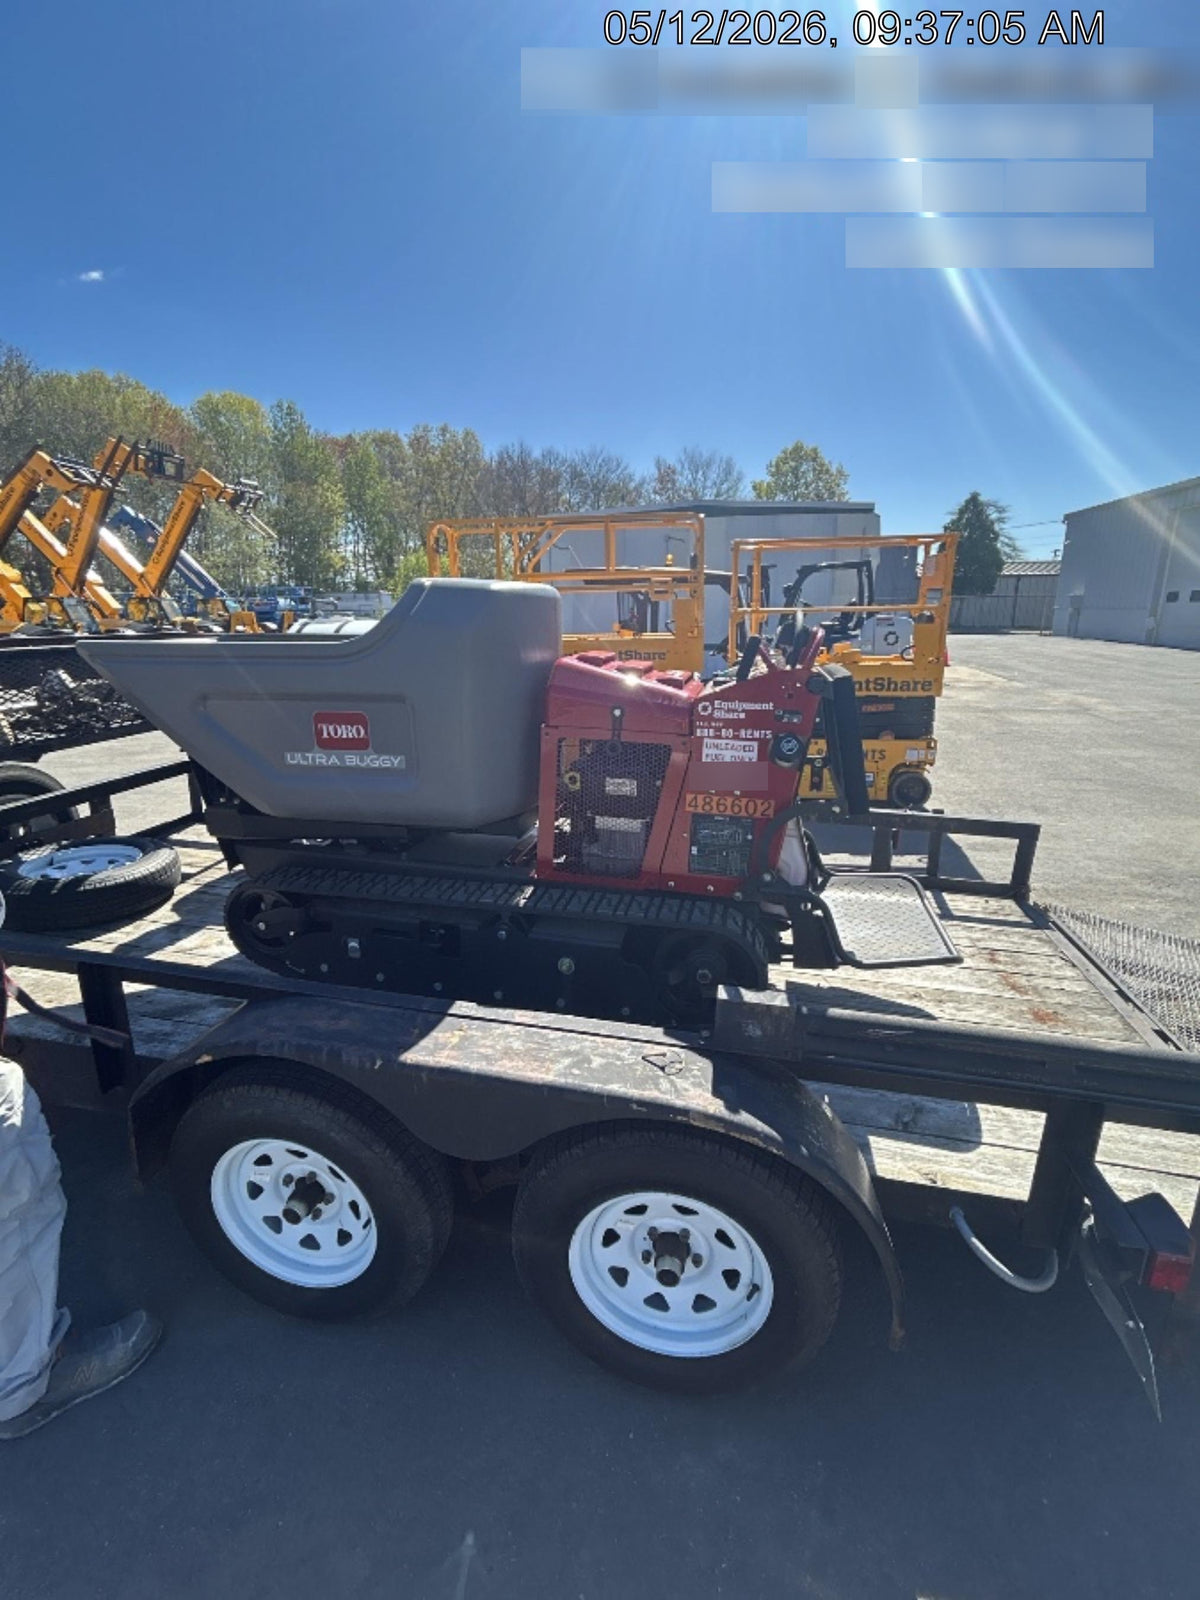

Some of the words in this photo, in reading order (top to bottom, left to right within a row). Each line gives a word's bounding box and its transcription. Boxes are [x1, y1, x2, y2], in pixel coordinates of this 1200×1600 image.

[713, 700, 774, 712] Equipment
[713, 708, 746, 719] Share
[318, 723, 367, 739] TORO
[286, 752, 341, 766] ULTRA
[344, 754, 402, 768] BUGGY
[687, 793, 772, 817] 486602
